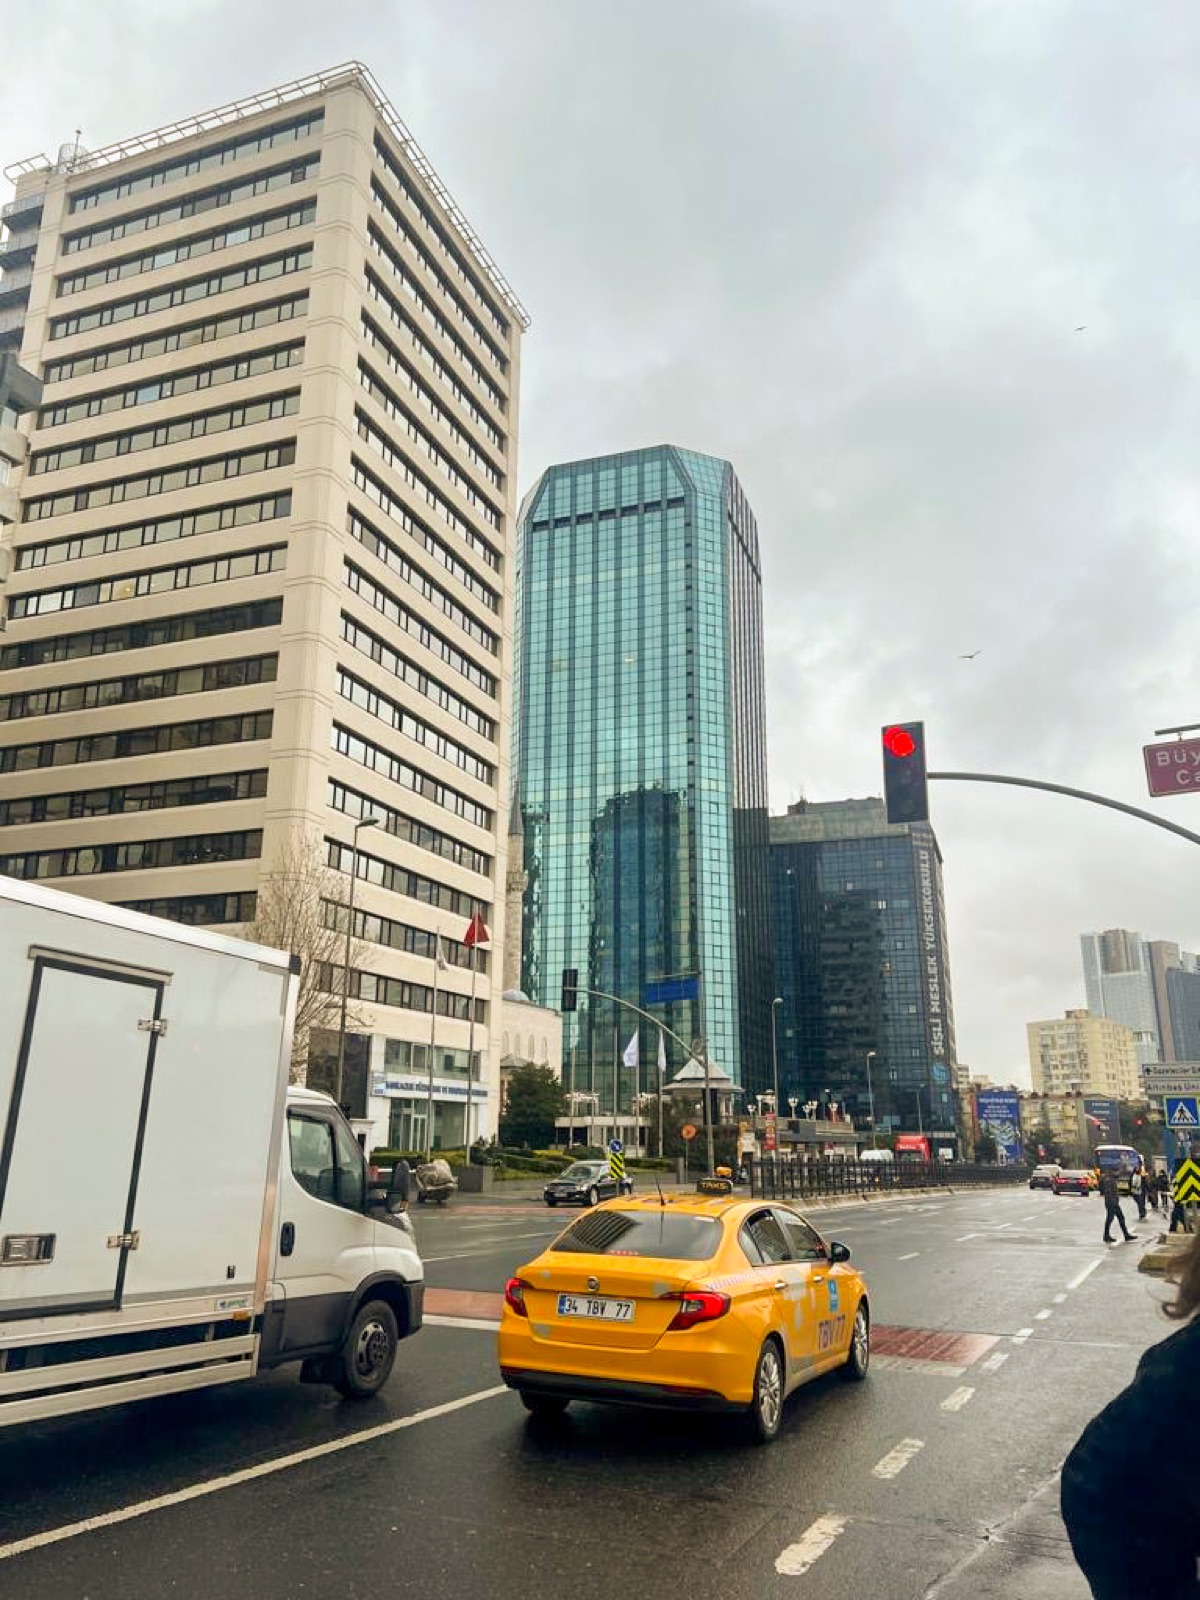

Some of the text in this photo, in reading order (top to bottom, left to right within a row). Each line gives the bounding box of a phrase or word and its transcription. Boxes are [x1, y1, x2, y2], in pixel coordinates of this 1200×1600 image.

[565, 1299, 630, 1318] 34 TBV 77
